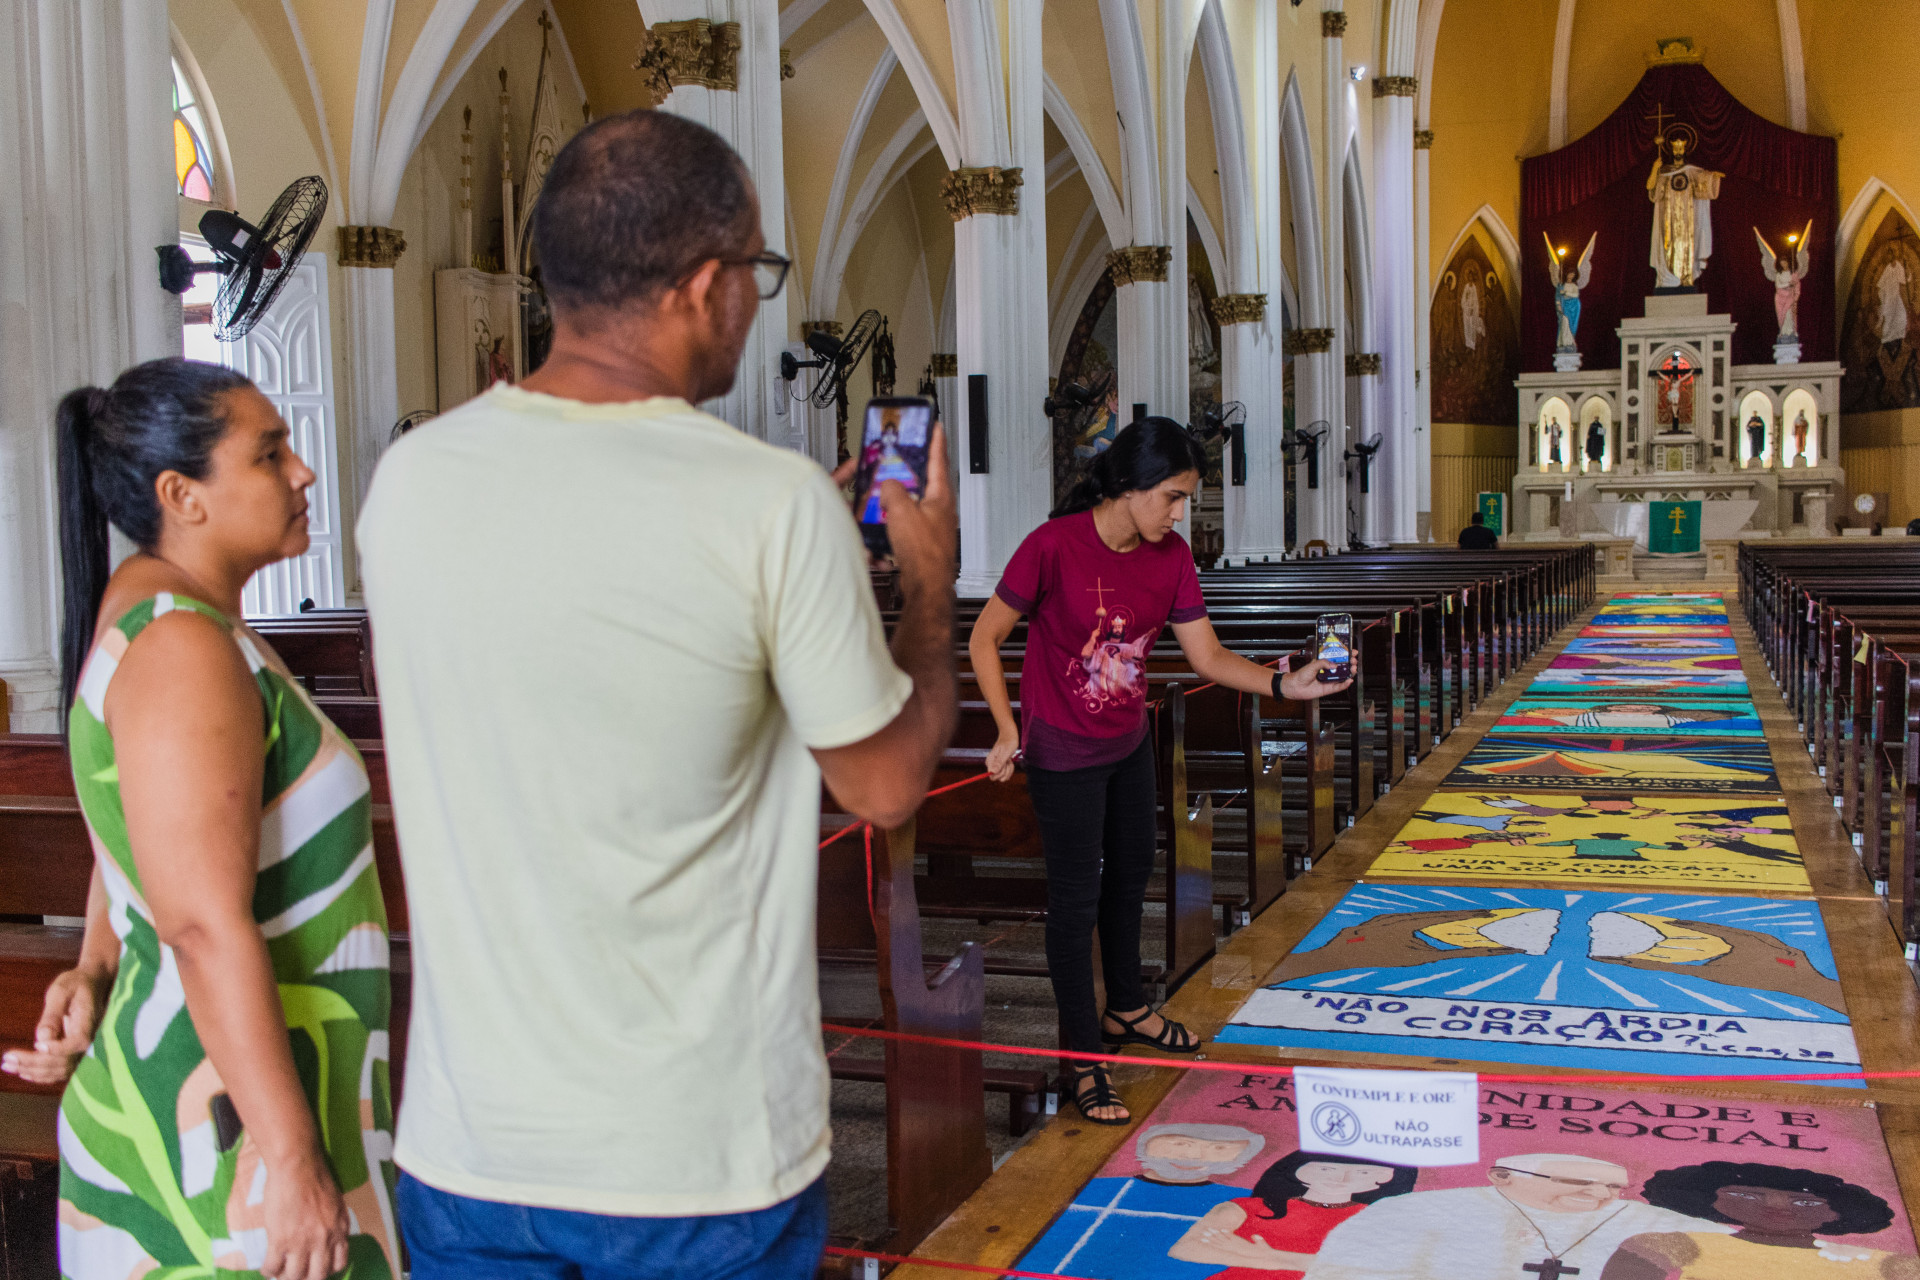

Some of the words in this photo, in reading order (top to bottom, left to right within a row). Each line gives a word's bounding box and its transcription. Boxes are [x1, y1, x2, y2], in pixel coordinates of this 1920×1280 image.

[1335, 1012, 1367, 1024] O
[1447, 1004, 1553, 1022] NOS
[1582, 1011, 1748, 1034] ARDIA
[1311, 1082, 1406, 1103] CONTEMPLE
[1409, 1092, 1420, 1103] E
[1422, 1091, 1456, 1104] ORE
[1394, 1118, 1430, 1133] NÃO
[1775, 1110, 1822, 1129] E
[1362, 1131, 1463, 1148] ULTRAPASSE
[1558, 1116, 1829, 1153] SOCIAL
